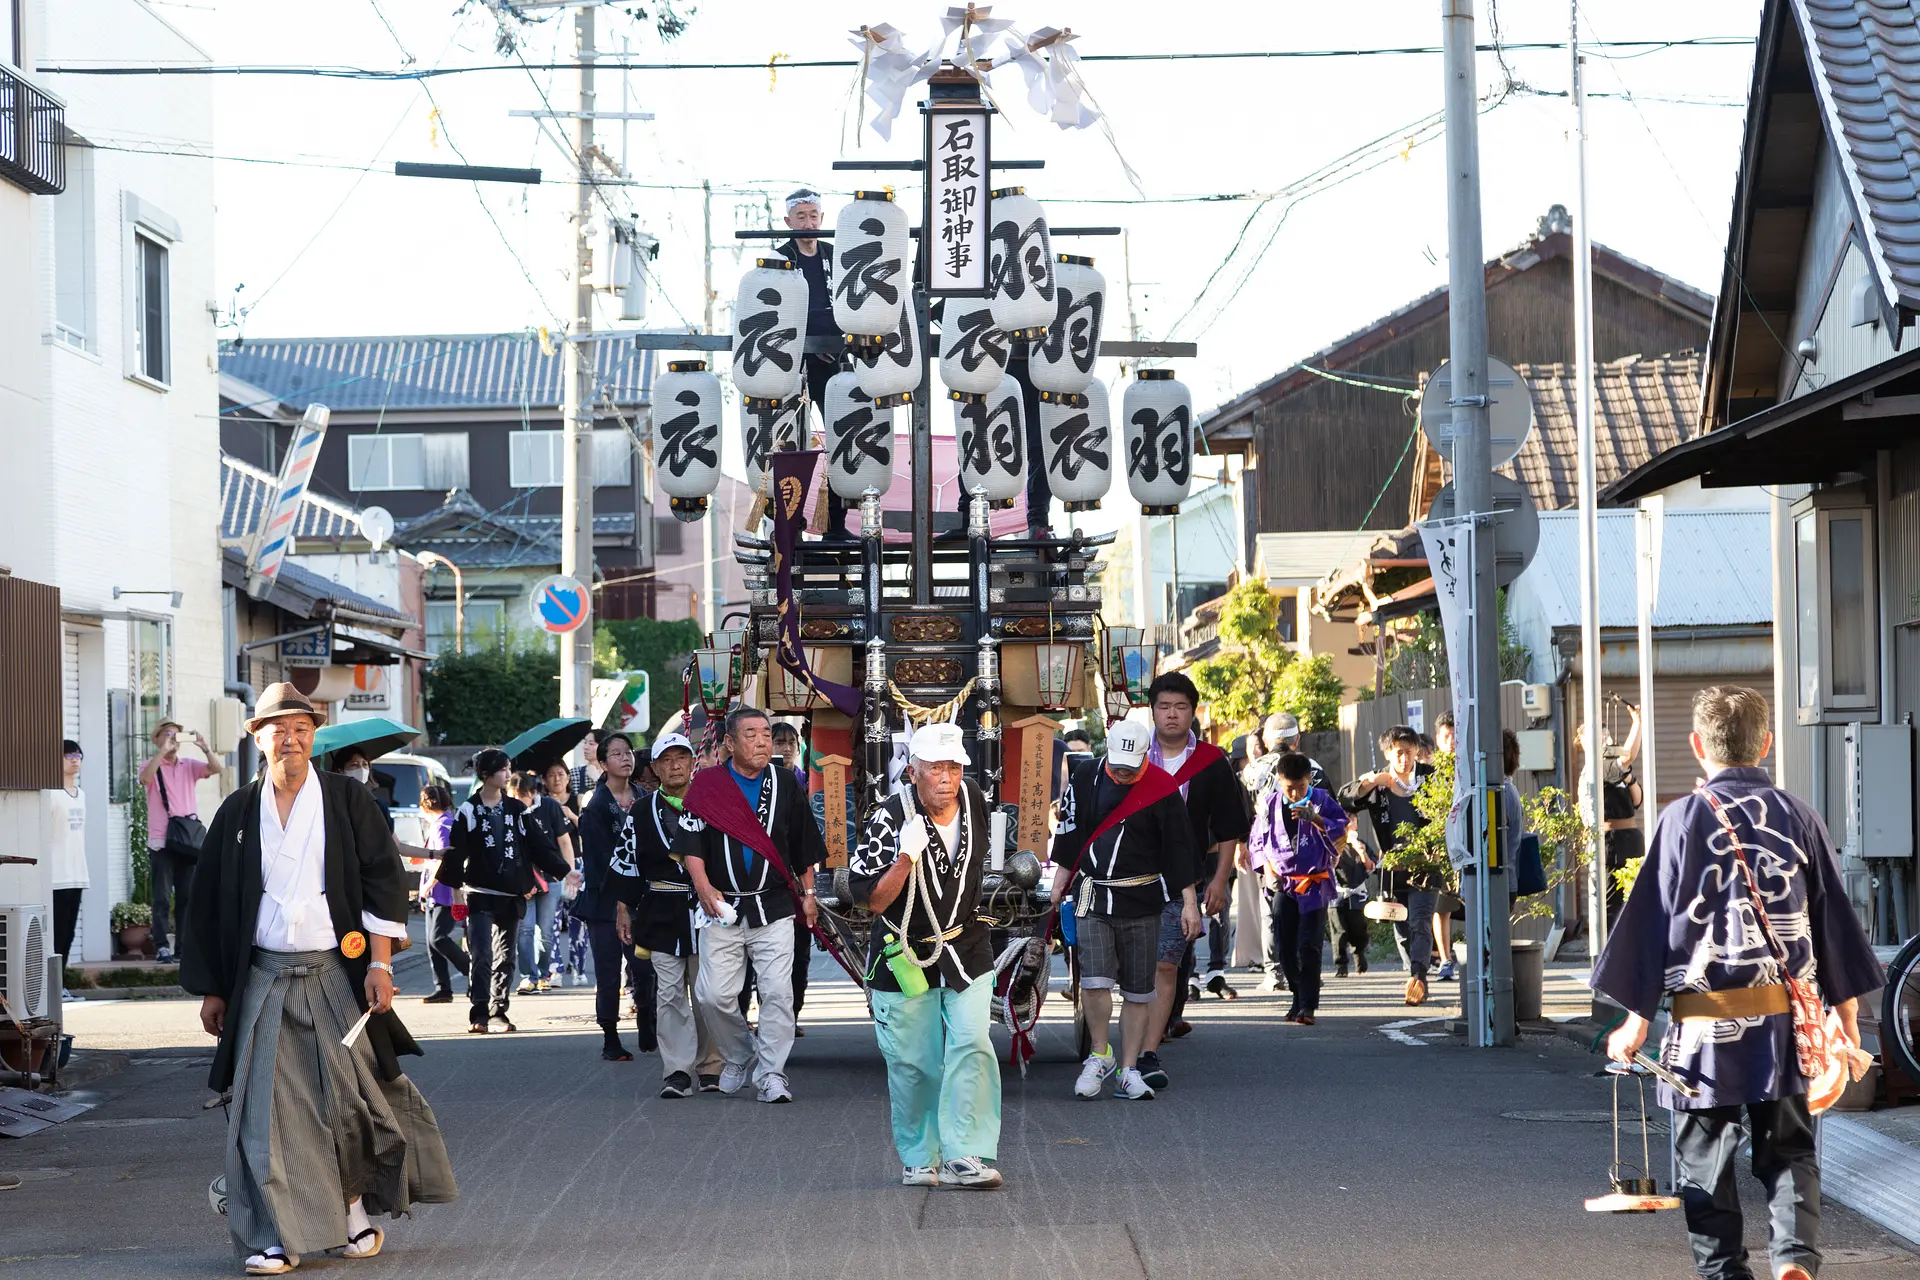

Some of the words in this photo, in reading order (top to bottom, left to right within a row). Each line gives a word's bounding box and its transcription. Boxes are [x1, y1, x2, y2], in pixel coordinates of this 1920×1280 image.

[939, 118, 980, 279] 石取御神事
[836, 218, 902, 311] 衣
[991, 217, 1055, 301] 羽
[733, 288, 798, 377] 衣
[1032, 287, 1103, 374] 羽
[658, 390, 718, 477] 衣
[831, 386, 892, 476] 衣
[961, 395, 1024, 477] 羽
[1050, 393, 1109, 481] 衣
[1129, 404, 1191, 486] 羽
[349, 694, 386, 704] ミエライス
[1121, 738, 1135, 752] TH
